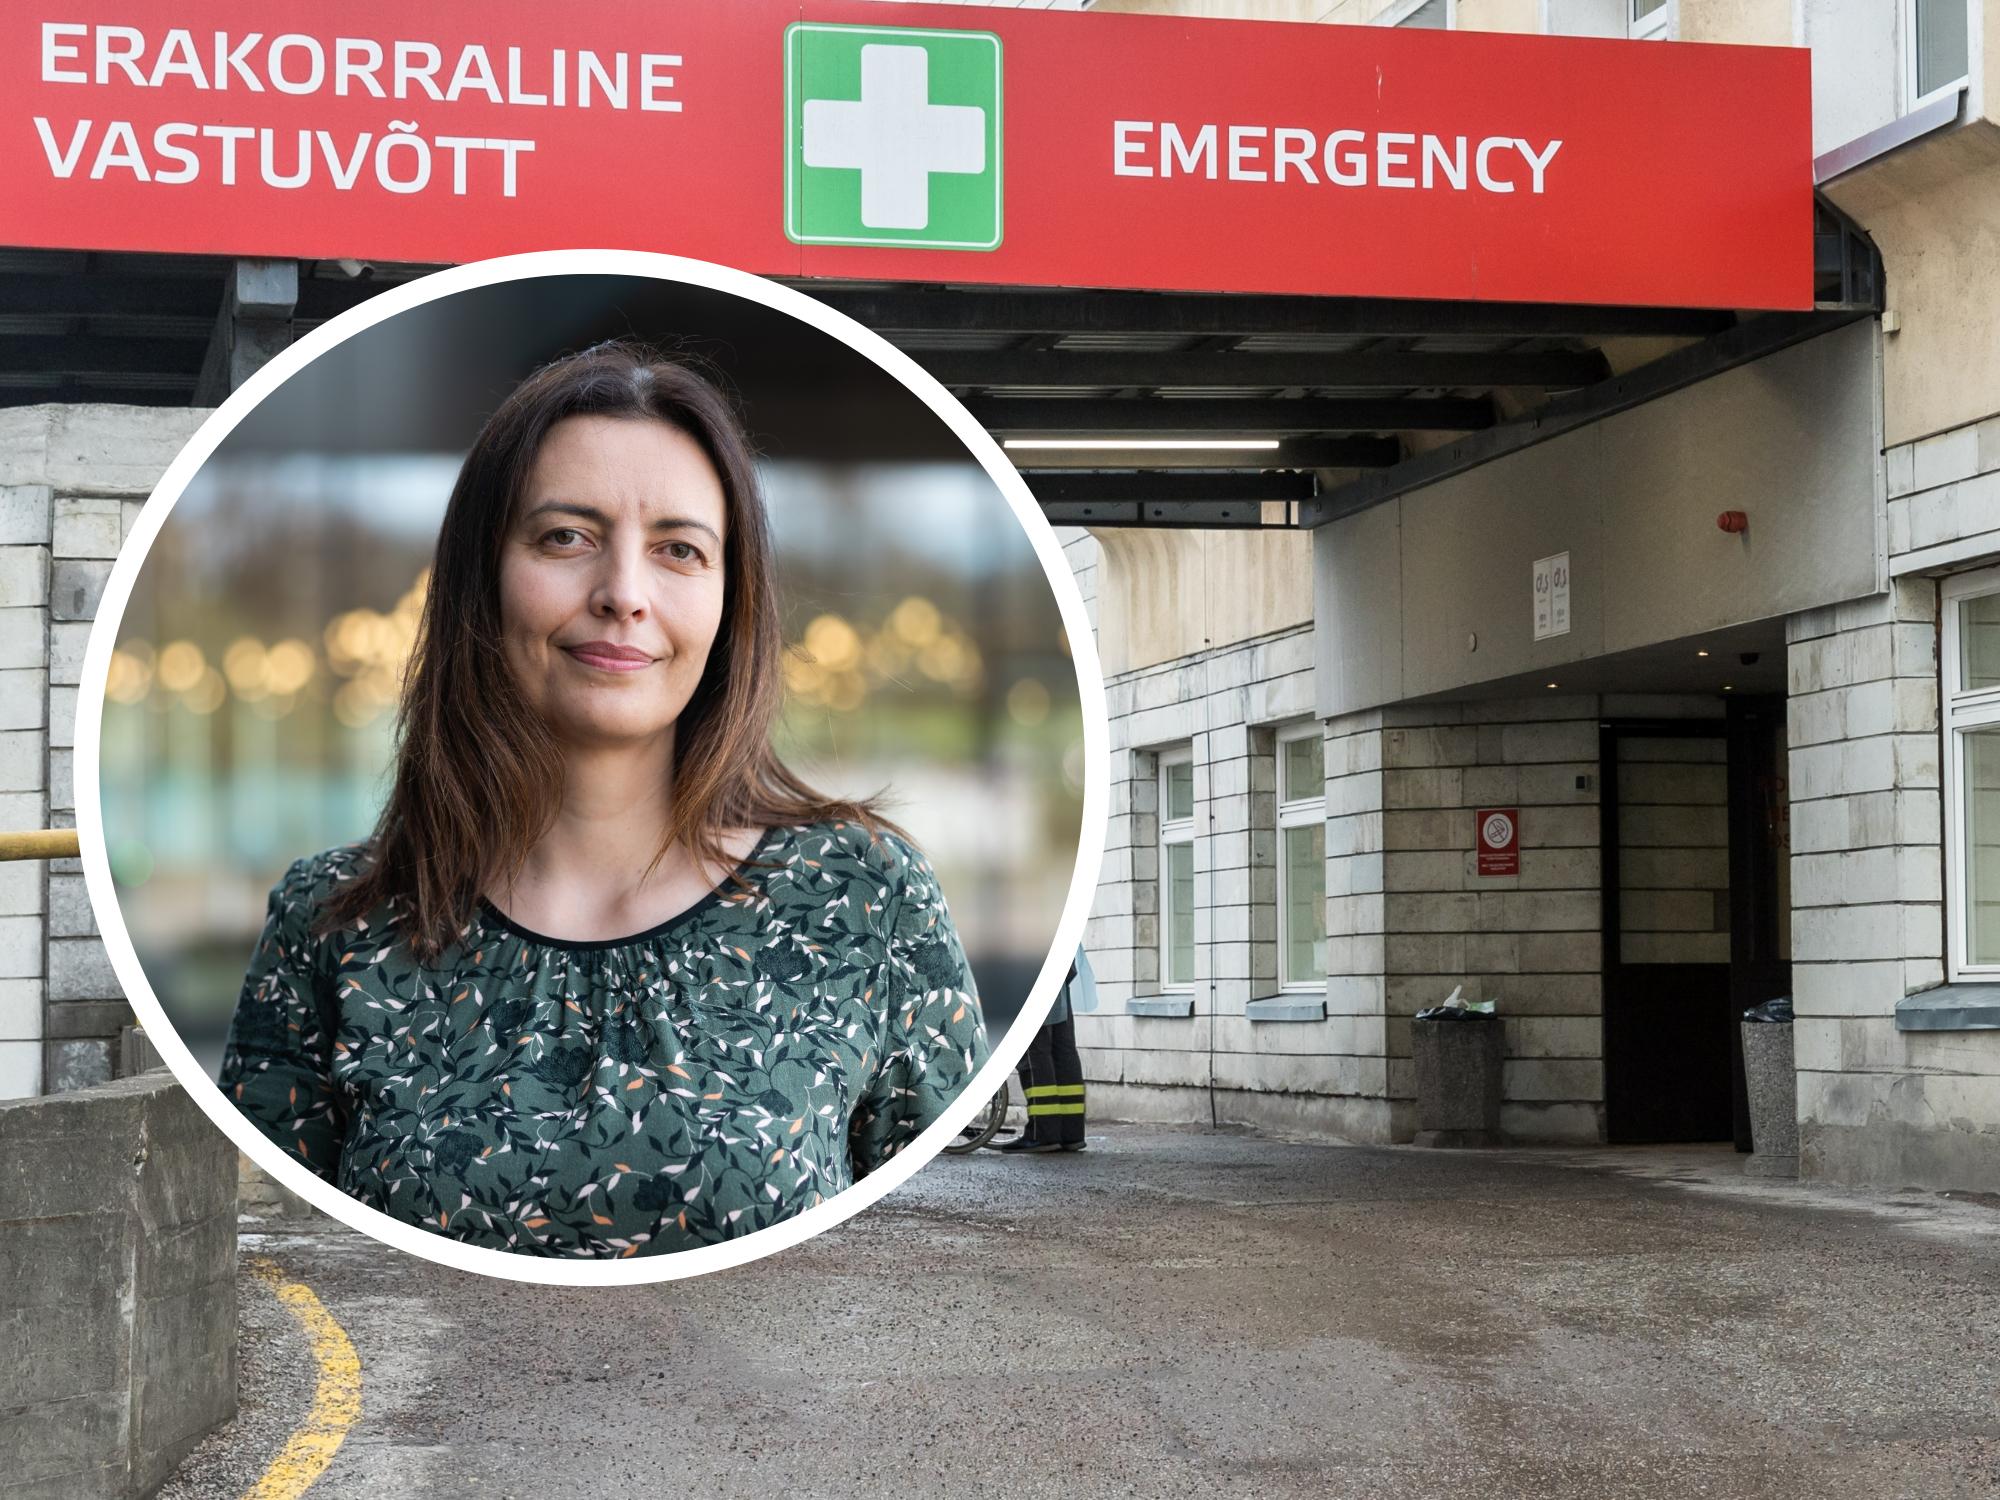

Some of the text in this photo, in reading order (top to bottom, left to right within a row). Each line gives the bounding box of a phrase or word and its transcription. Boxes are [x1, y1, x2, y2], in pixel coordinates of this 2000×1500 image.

[41, 22, 684, 114] ERAKORRALINE
[33, 116, 536, 197] VASTUVÕTT
[1114, 120, 1563, 194] EMERGENCY
